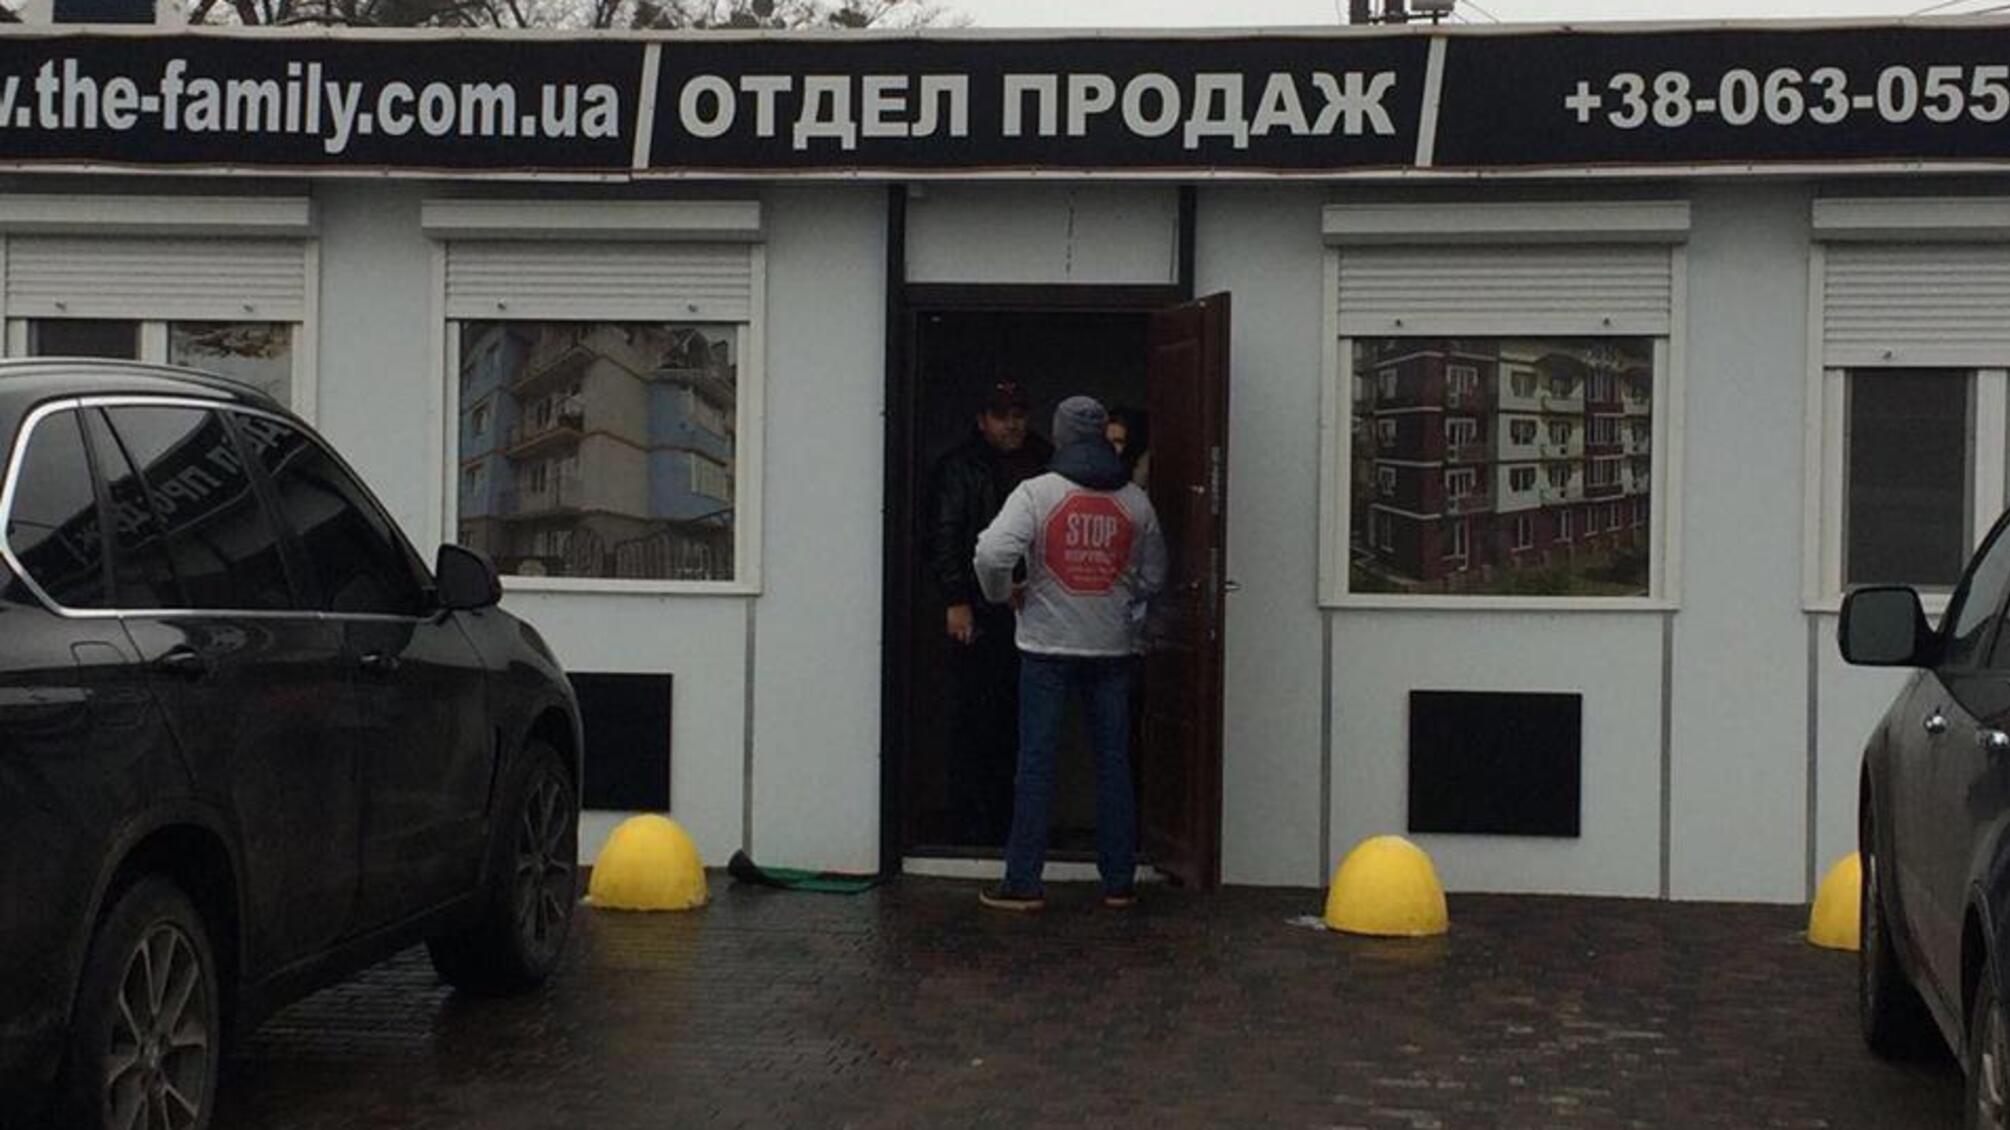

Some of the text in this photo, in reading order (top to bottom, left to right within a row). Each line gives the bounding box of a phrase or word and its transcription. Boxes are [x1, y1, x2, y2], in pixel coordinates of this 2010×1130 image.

[679, 71, 1396, 150] ОТДЕЛ ПРОДАЖ
[1565, 65, 2010, 129] +38-063-055
[1066, 512, 1117, 547] STOP
